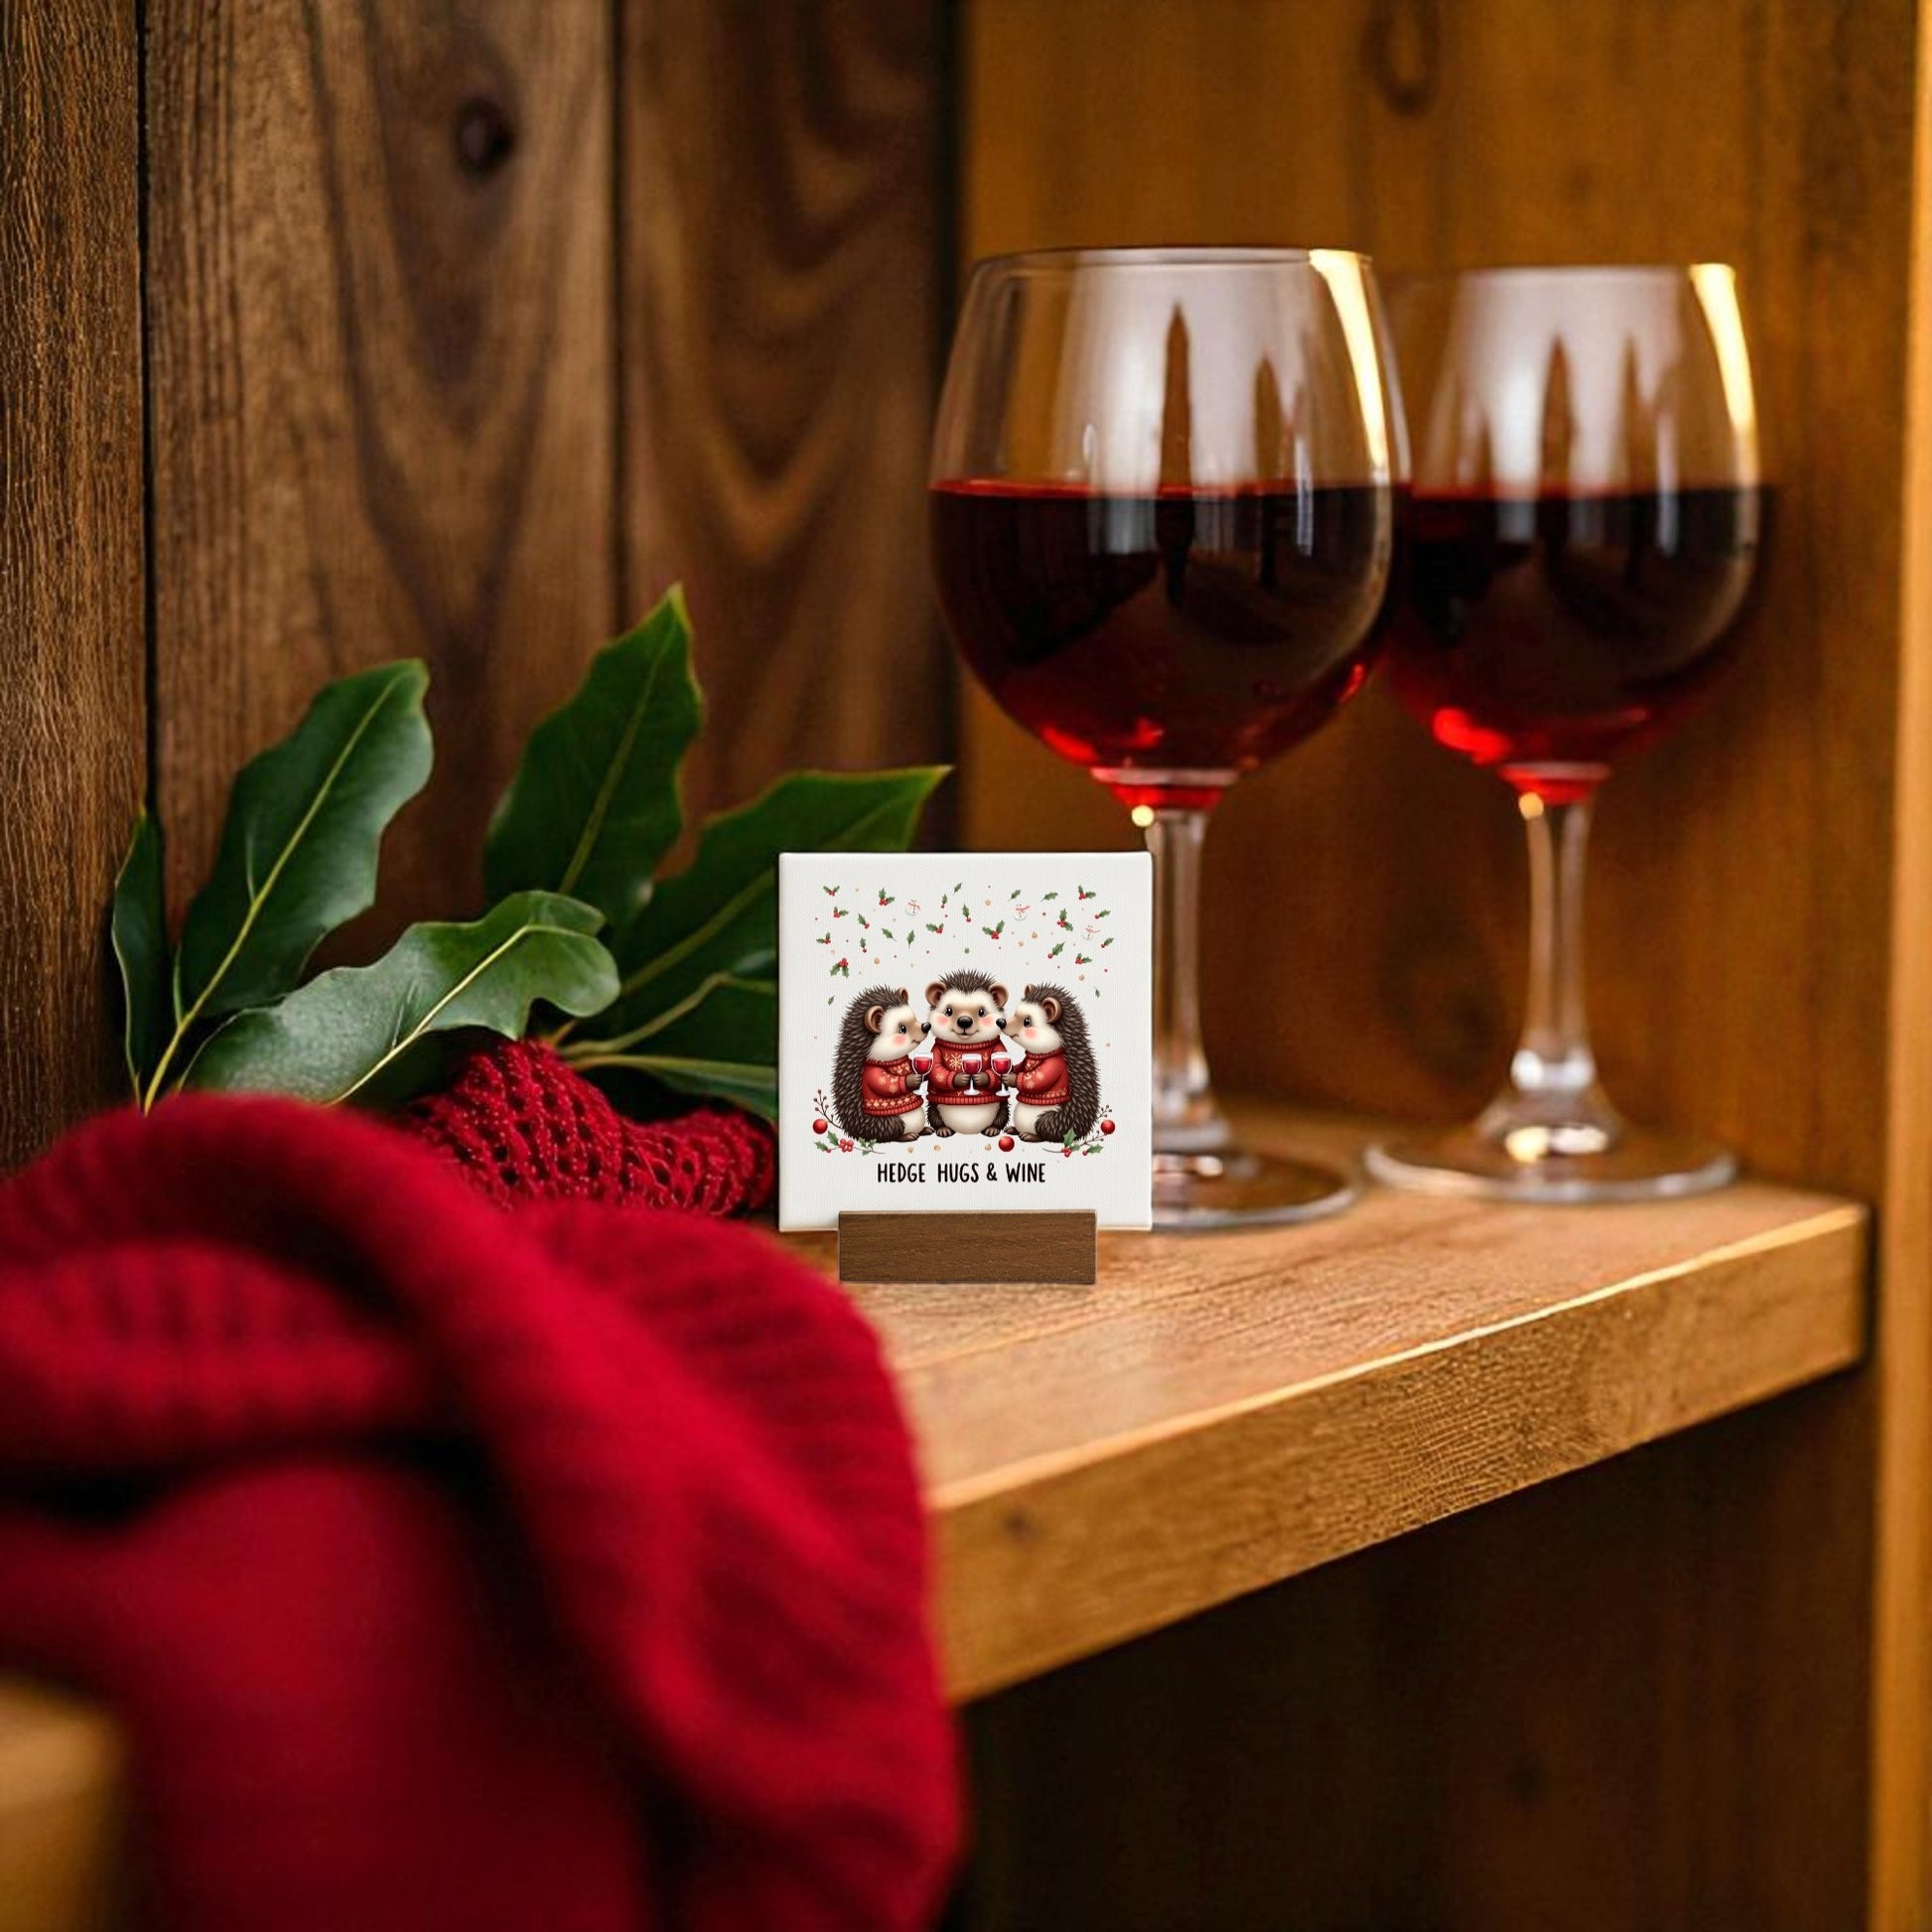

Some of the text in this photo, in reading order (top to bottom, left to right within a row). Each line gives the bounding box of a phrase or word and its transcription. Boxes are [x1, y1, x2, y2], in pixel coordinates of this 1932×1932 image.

[877, 1162, 1045, 1182] HEDGE HUGS & WINE
